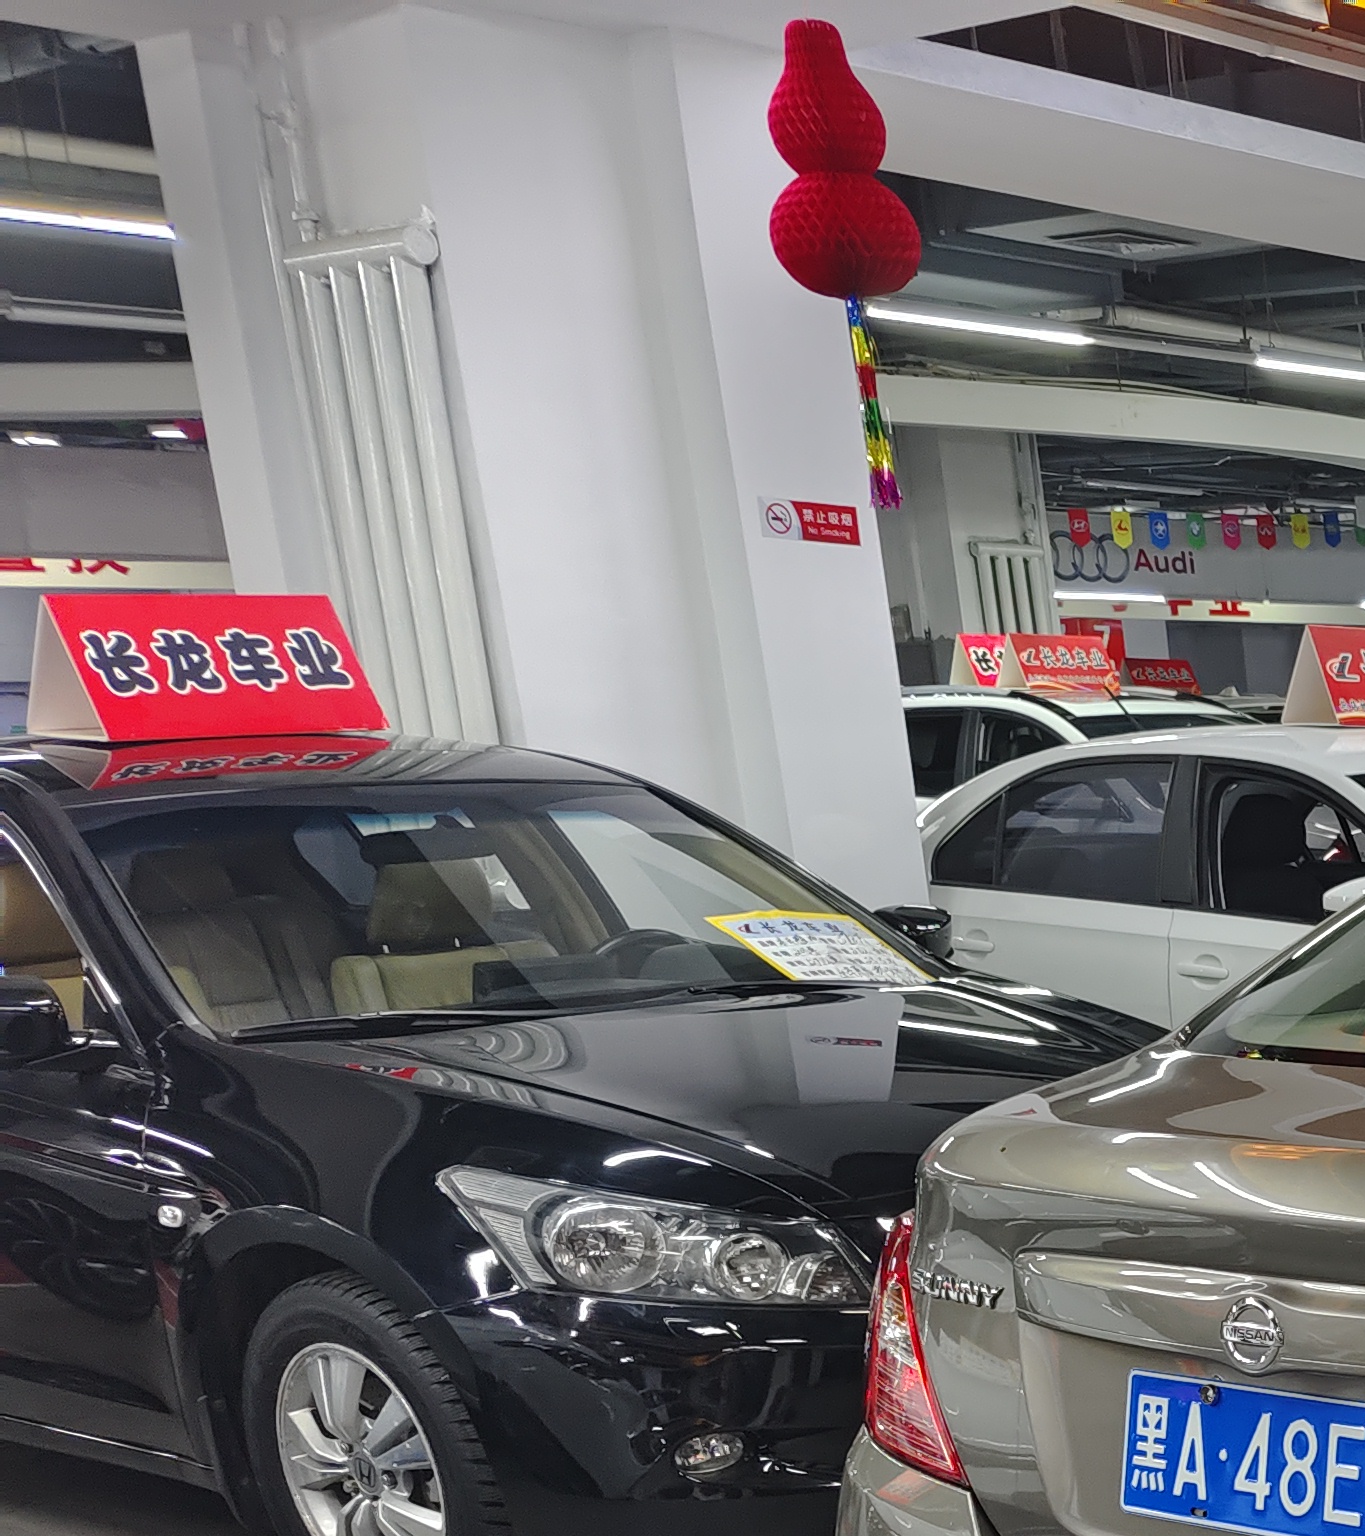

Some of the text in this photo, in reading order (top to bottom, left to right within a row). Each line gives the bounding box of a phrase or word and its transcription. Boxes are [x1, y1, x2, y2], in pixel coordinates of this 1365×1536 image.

[802, 508, 853, 527] 禁止吸烟
[807, 526, 851, 541] No Smoking
[1134, 548, 1195, 575] Audi
[79, 627, 355, 698] 长龙车业
[1040, 646, 1108, 671] 长龙车业
[912, 1267, 1005, 1310] SUNNY
[1224, 1325, 1275, 1343] NISSAN
